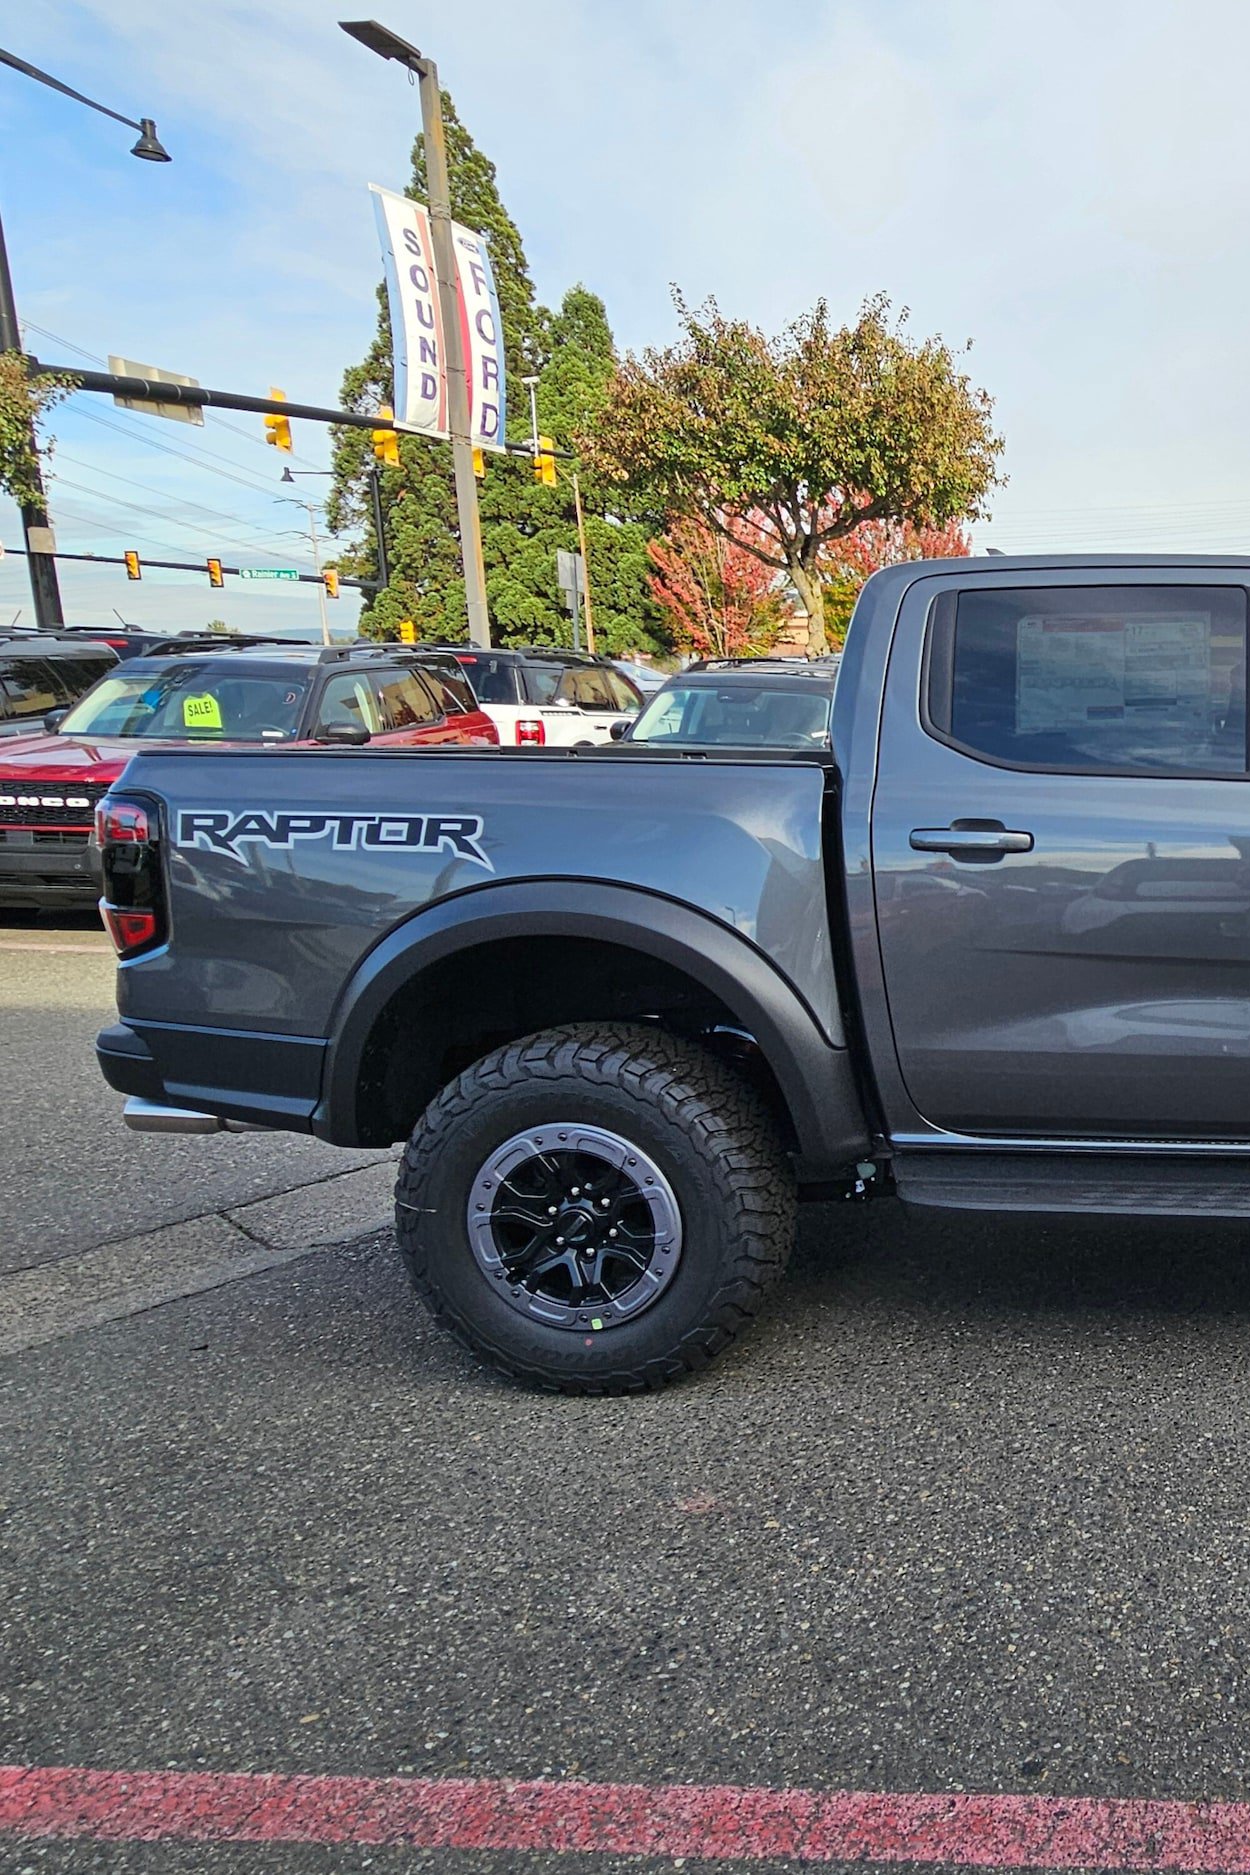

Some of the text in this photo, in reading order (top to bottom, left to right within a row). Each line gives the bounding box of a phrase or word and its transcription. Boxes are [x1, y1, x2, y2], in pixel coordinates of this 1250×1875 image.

[402, 227, 438, 401] SOUND
[468, 260, 499, 438] FORD
[187, 701, 214, 717] SALE!
[177, 809, 496, 874] RAPTOR
